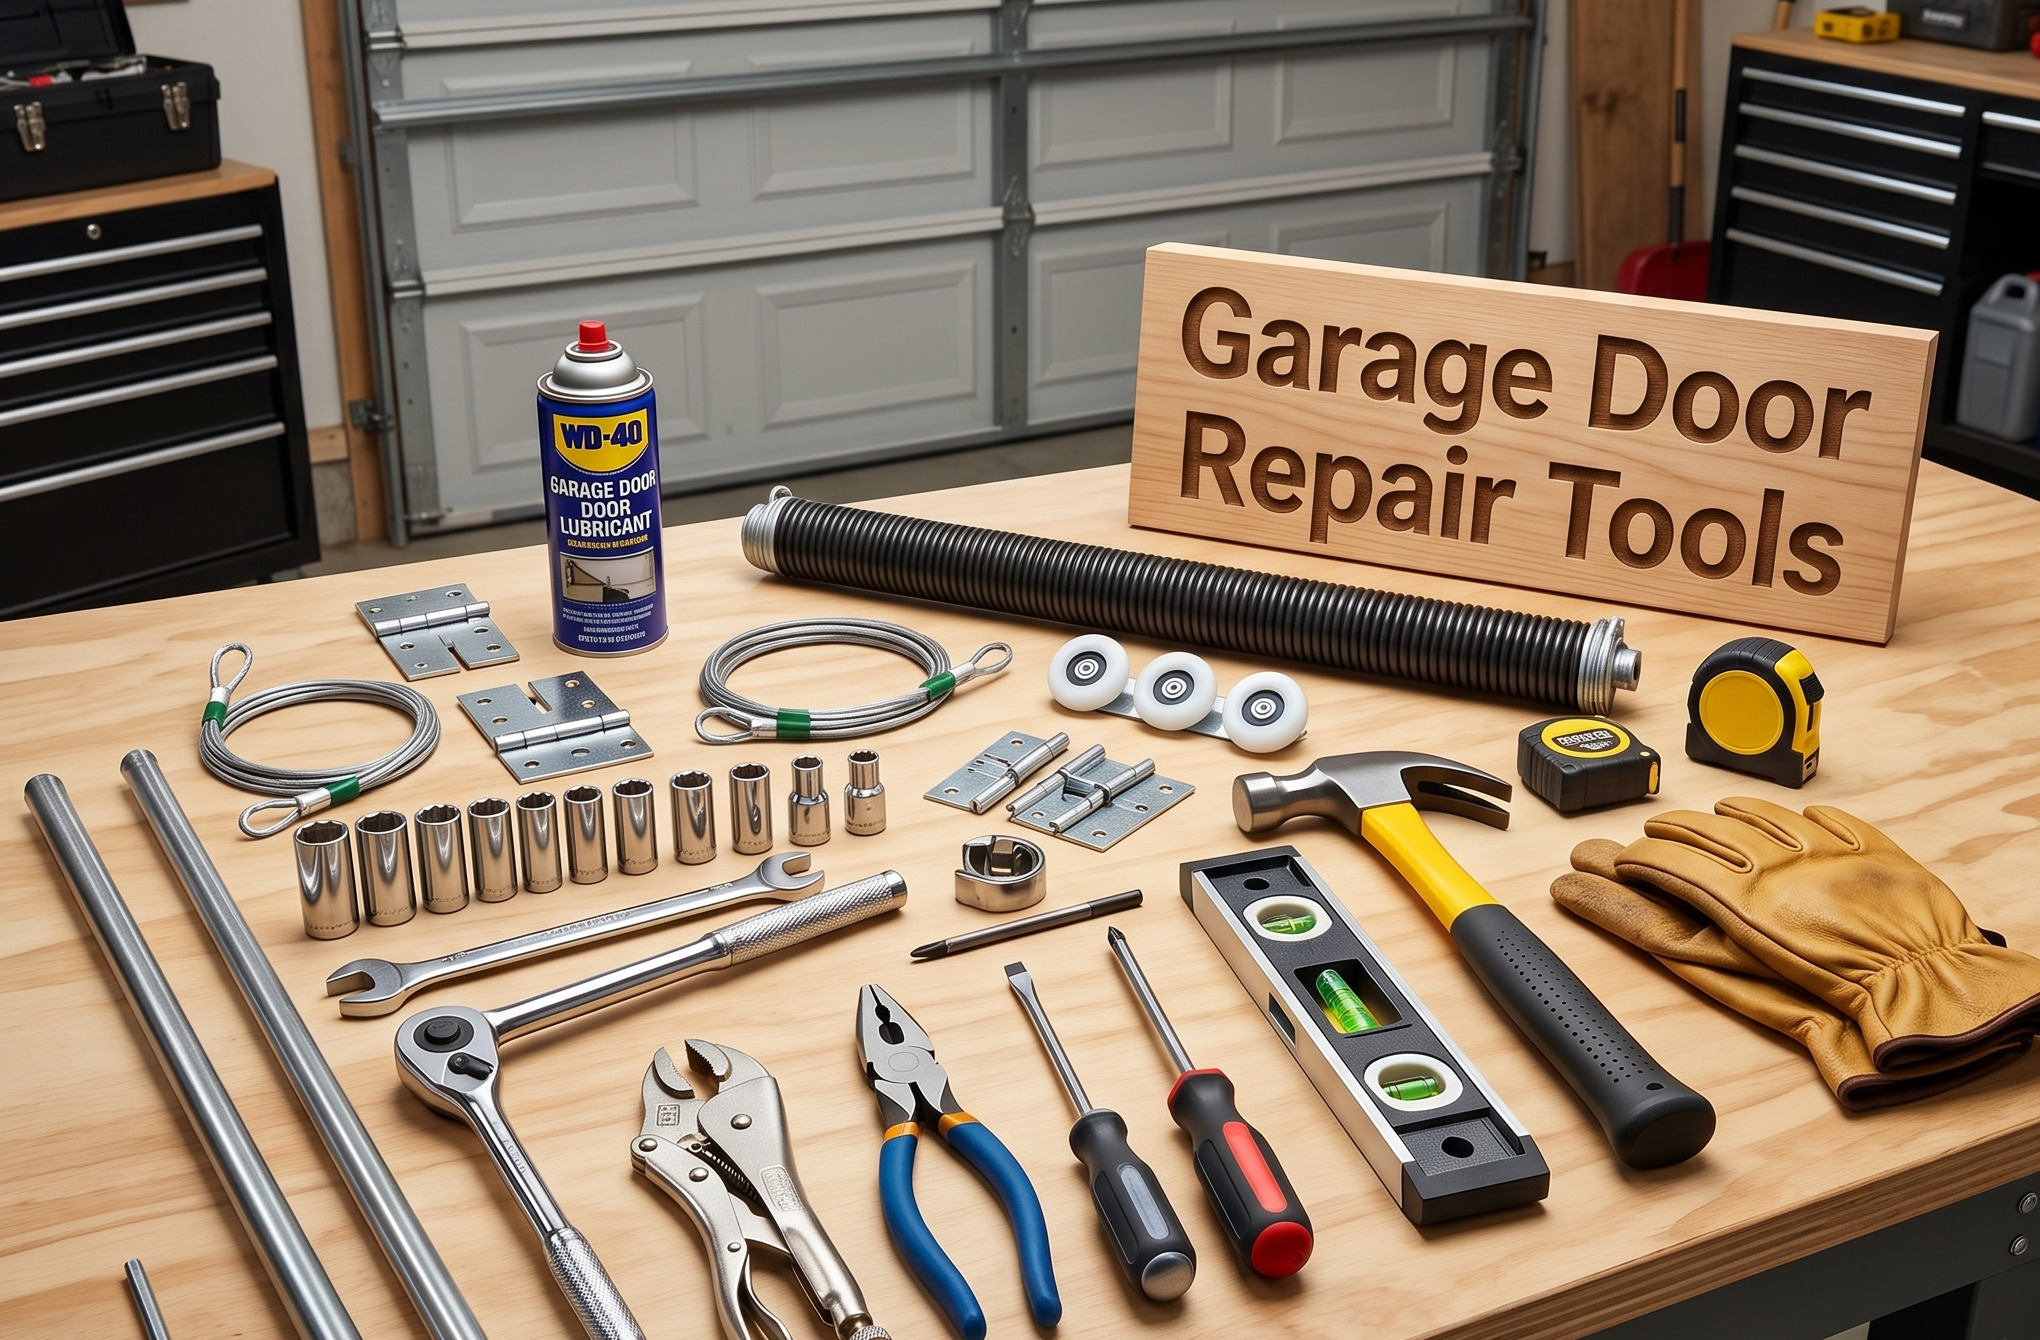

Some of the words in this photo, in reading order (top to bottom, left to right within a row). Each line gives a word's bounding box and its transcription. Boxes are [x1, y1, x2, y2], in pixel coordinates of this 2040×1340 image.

[1181, 285, 1553, 436] Garage
[1588, 333, 1872, 460] Door
[560, 420, 643, 450] WD-40
[550, 475, 615, 499] GARAGE
[619, 469, 656, 497] DOOR
[581, 499, 631, 519] DOOR
[1181, 409, 1517, 545] Repair
[1548, 460, 1845, 597] Tools
[560, 509, 653, 538] LUBRICANT
